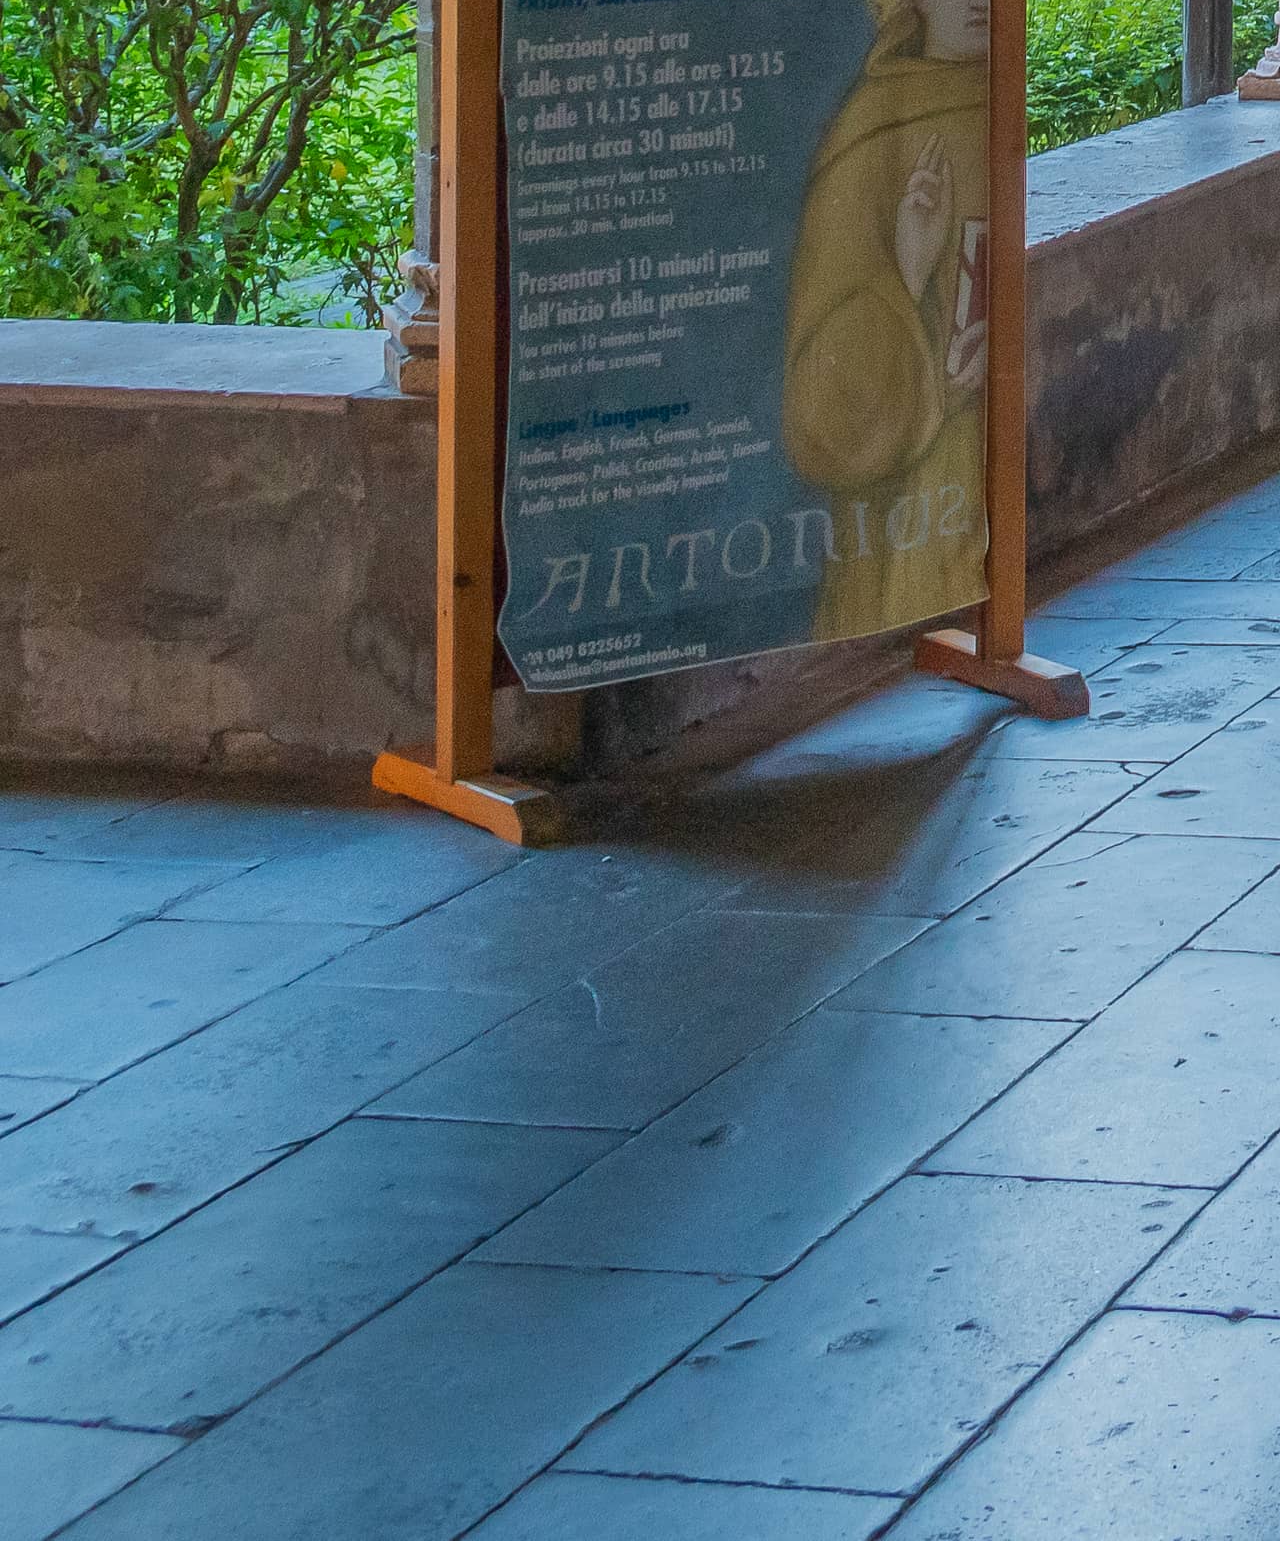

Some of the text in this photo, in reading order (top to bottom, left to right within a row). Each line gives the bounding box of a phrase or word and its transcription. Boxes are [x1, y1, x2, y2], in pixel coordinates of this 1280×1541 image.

[517, 30, 690, 63] Proiezioni ogni ora
[517, 50, 785, 98] dalle ore 9.15 alle ore 12.15
[517, 87, 743, 133] e dalle 14.15 alle 17.15
[517, 121, 736, 169] (durata circa 30 minuti)
[619, 169, 645, 184] hour
[650, 165, 678, 181] from
[681, 160, 710, 178] 9.15
[729, 154, 767, 174] 12.15
[575, 194, 610, 213] 14.15
[613, 192, 626, 207] to
[630, 187, 667, 206] 17.15
[571, 218, 588, 235] 30
[518, 245, 769, 296] Presentarsi 10 minuti prima
[610, 289, 655, 318] della
[659, 282, 750, 319] proiezione
[558, 489, 587, 509] track
[591, 487, 610, 504] for
[613, 483, 632, 501] the
[547, 644, 574, 663] 049
[578, 633, 642, 657] 8225652
